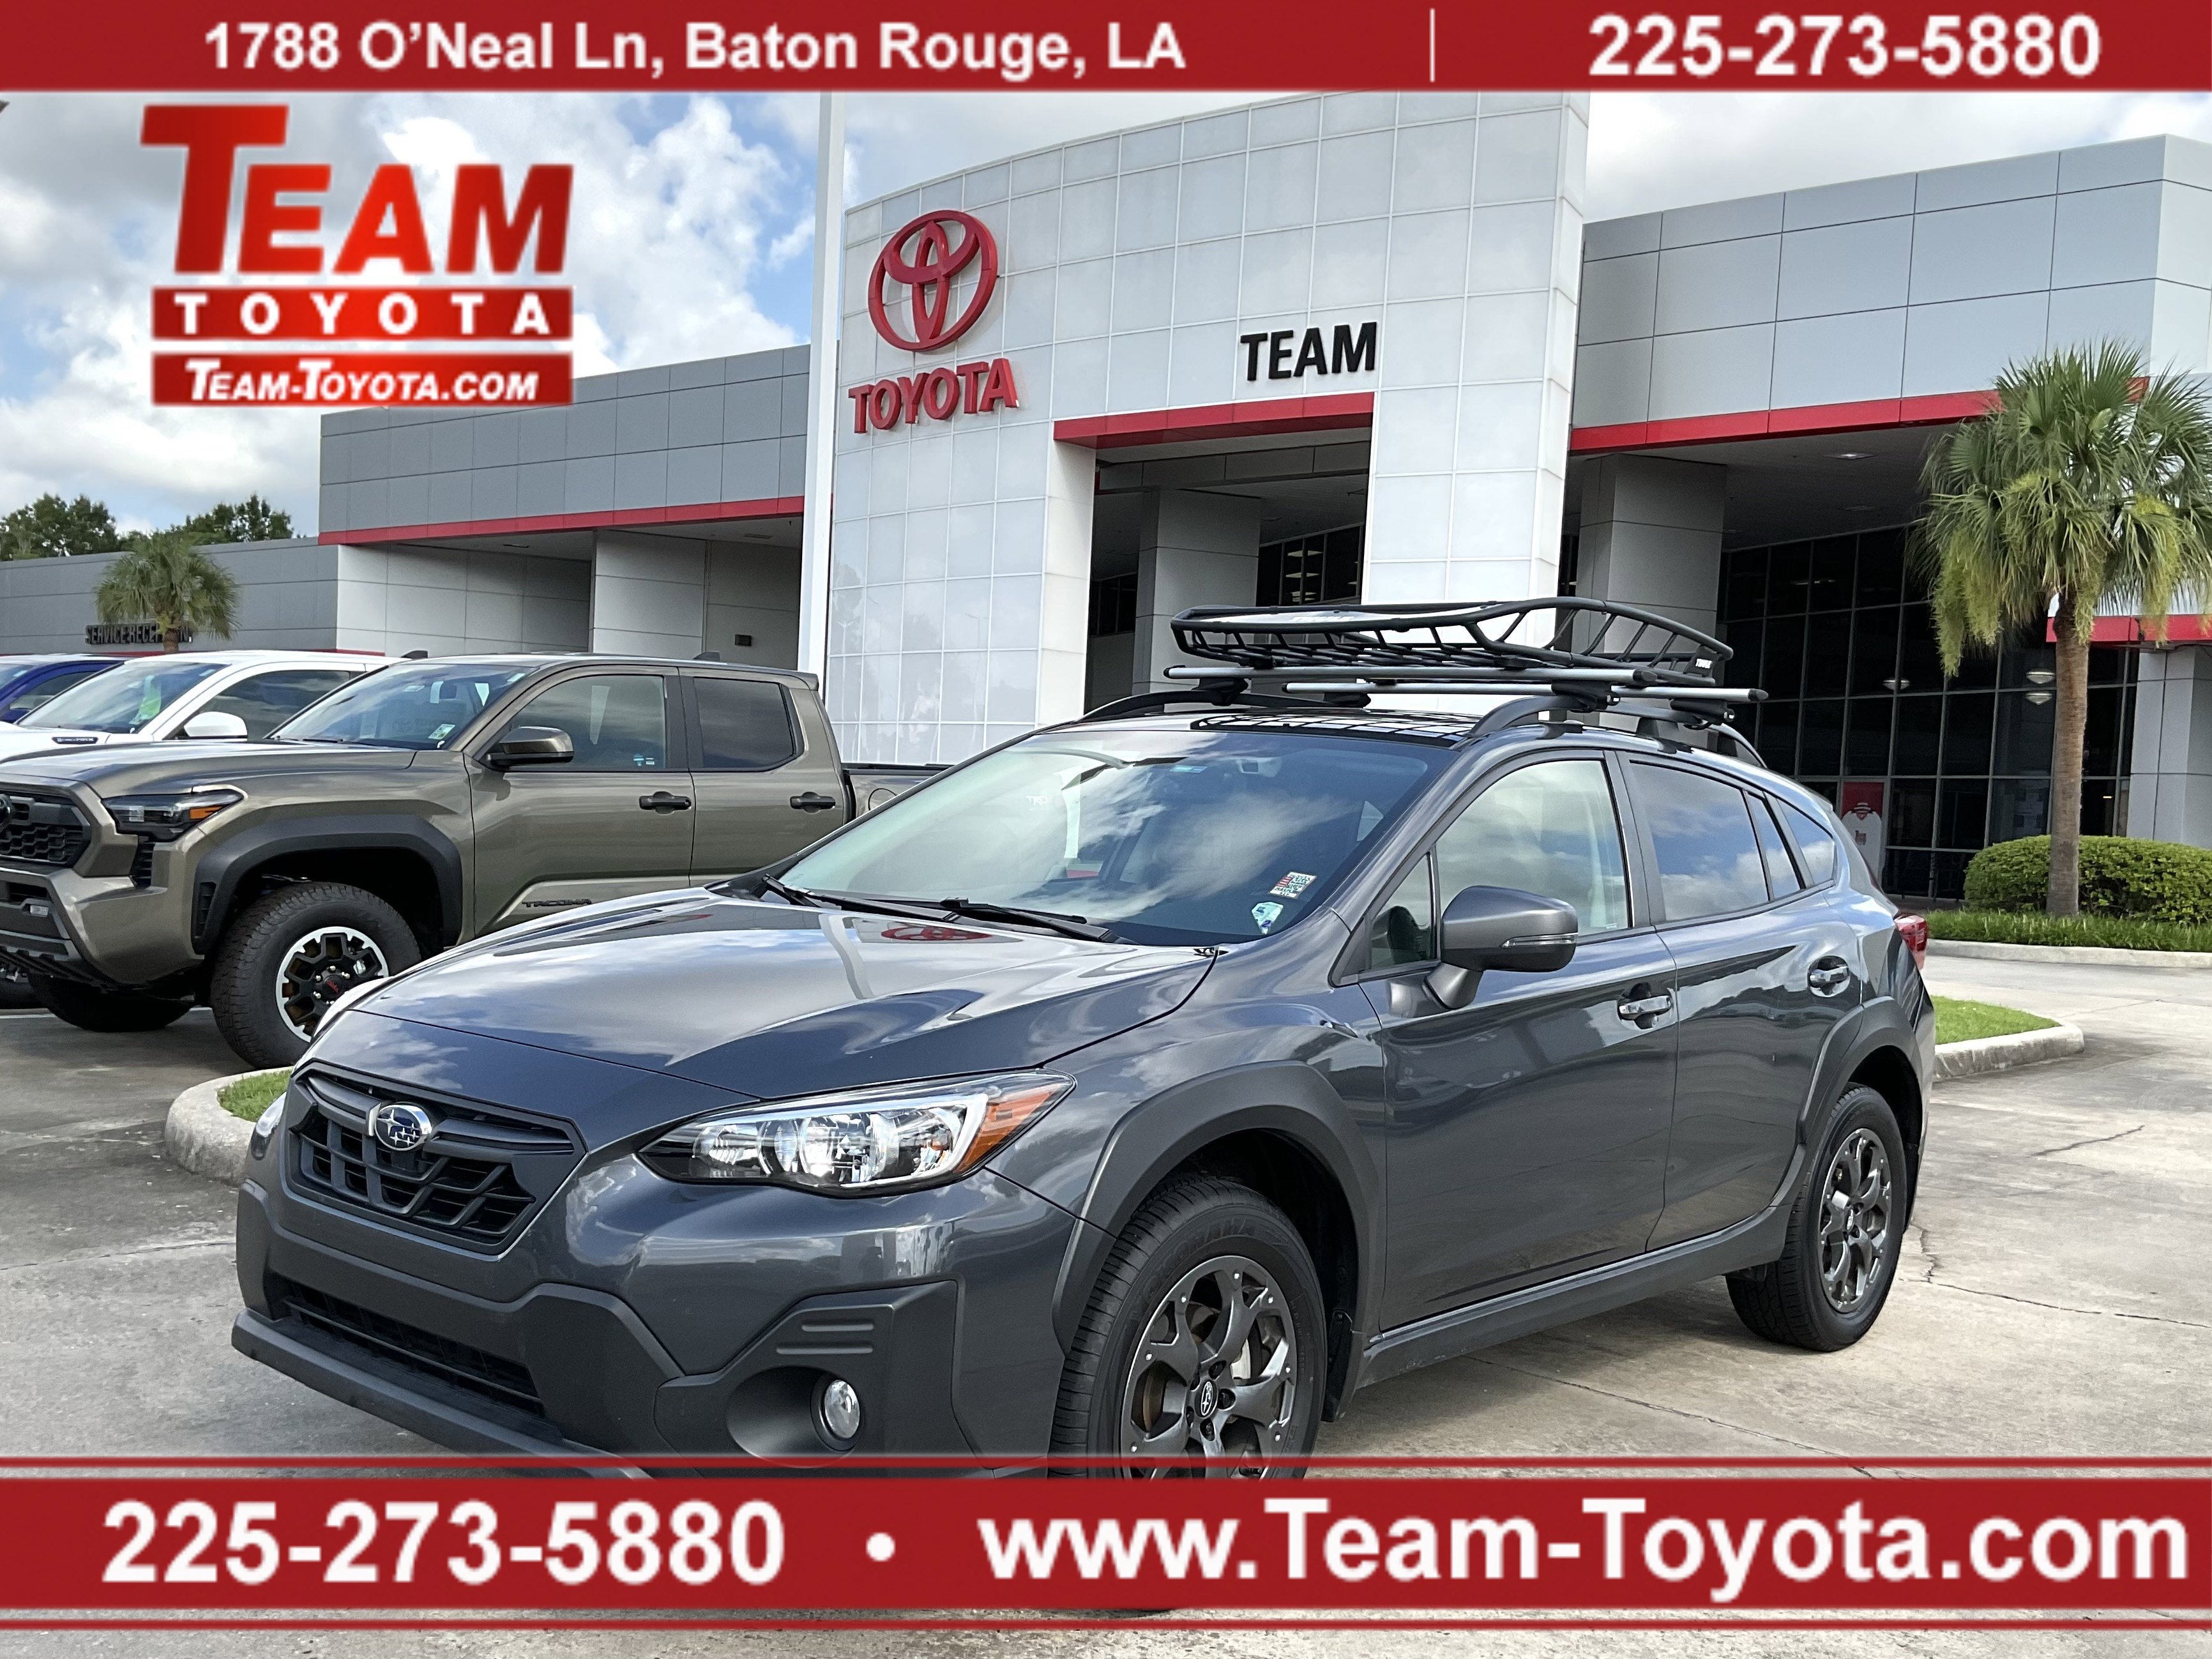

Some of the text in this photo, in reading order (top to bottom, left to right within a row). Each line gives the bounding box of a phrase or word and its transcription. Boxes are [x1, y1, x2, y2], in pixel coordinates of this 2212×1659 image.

[1240, 321, 1377, 381] TEAM
[847, 358, 1019, 434] TOYOTA
[85, 625, 129, 644] SERVICE
[522, 898, 592, 907] TACOMA
